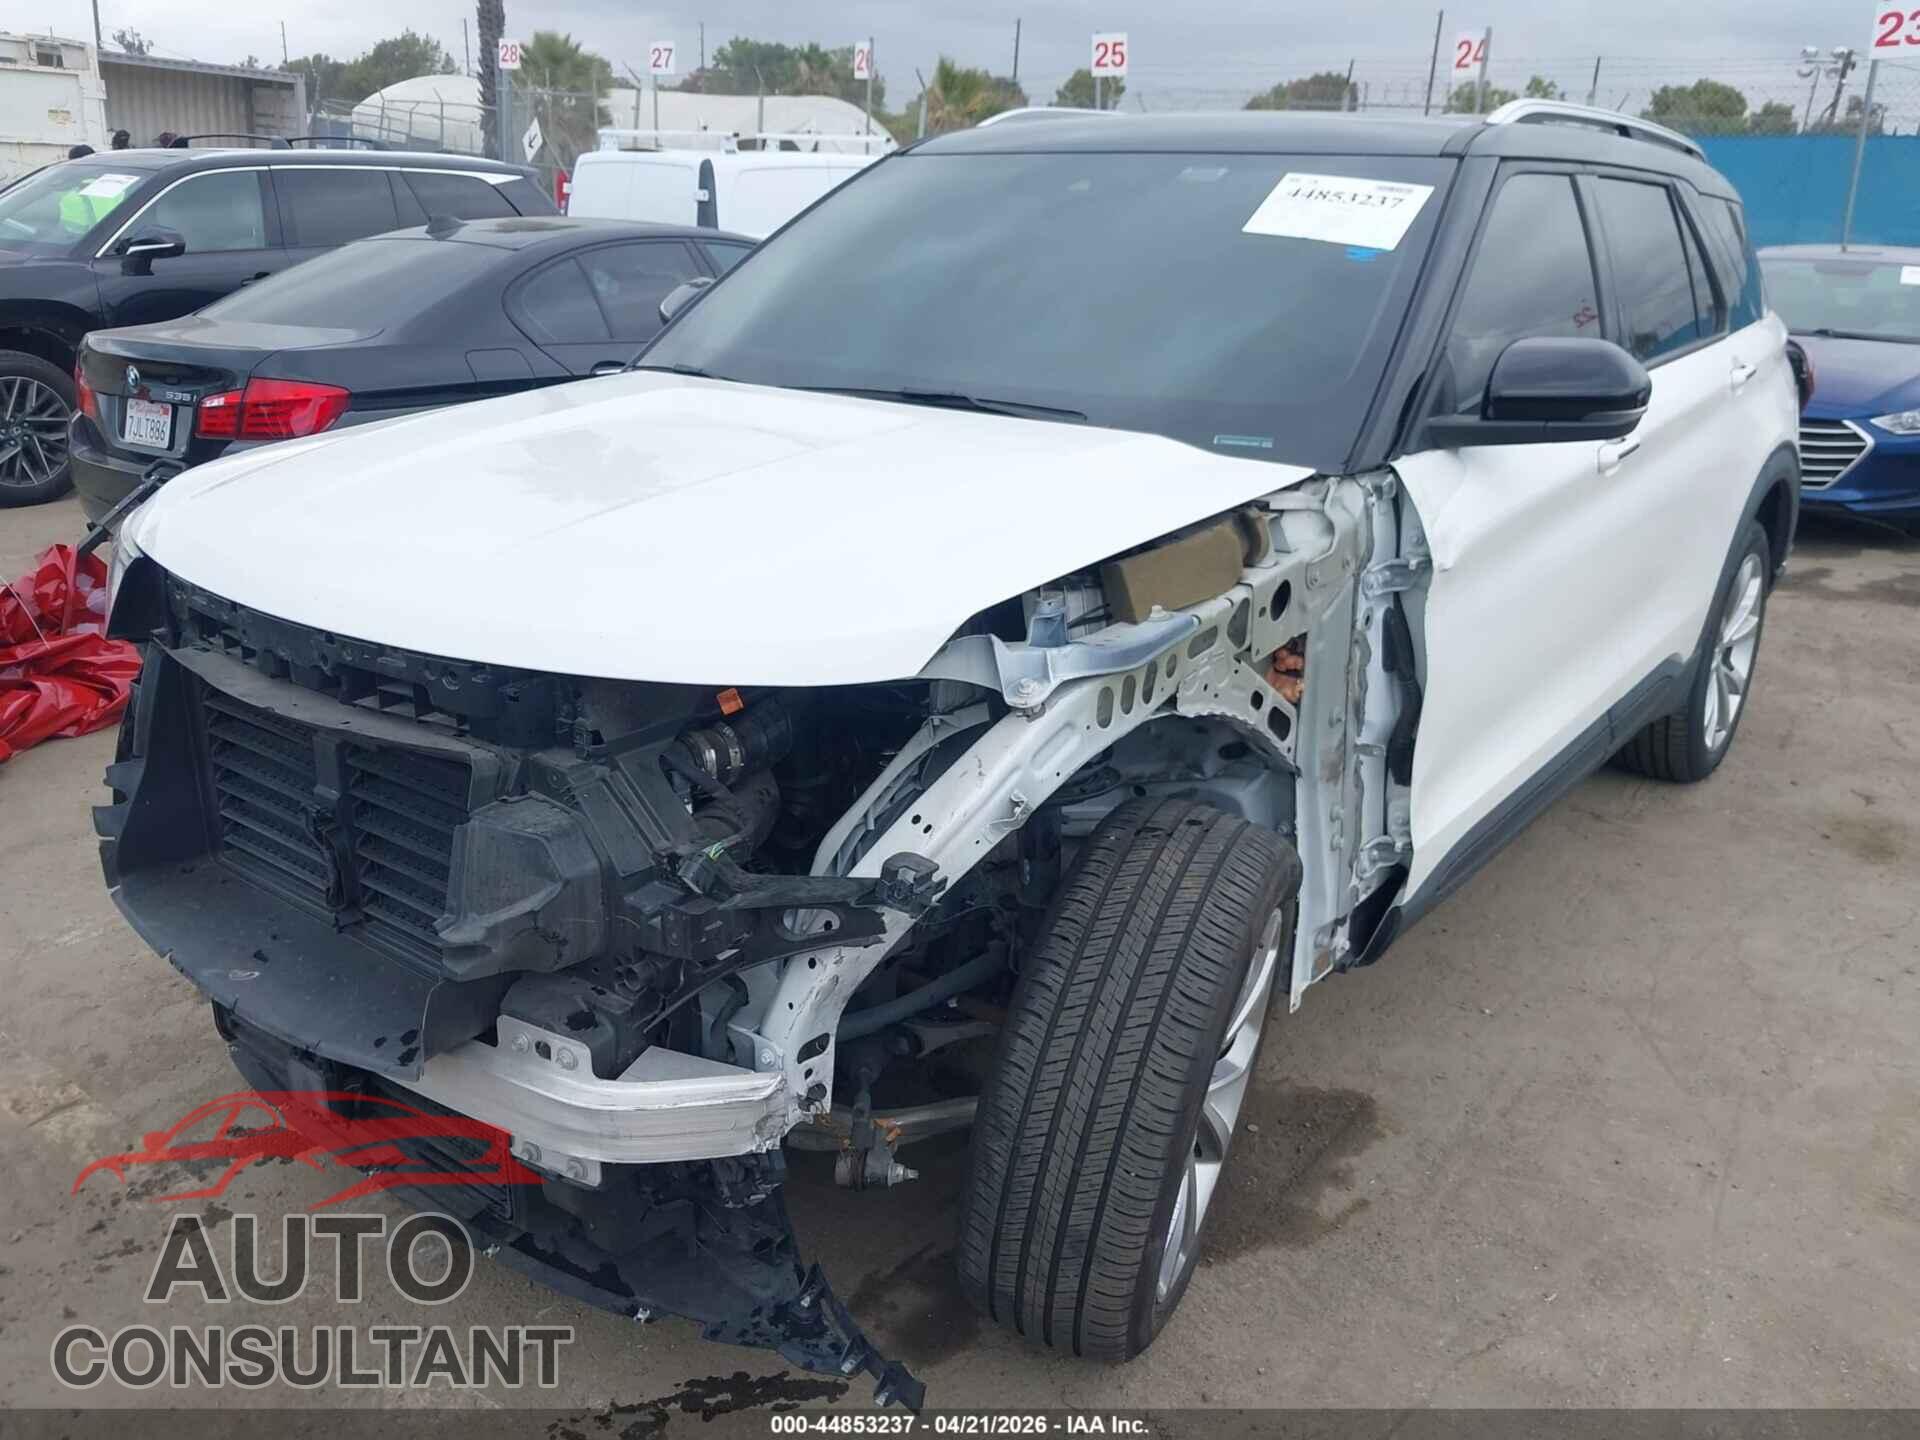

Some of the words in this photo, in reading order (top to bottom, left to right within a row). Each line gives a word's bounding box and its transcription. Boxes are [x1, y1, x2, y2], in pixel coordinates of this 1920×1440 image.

[501, 44, 518, 63] 28
[651, 47, 673, 68] 27
[1095, 41, 1125, 68] 25
[1455, 40, 1487, 69] 24
